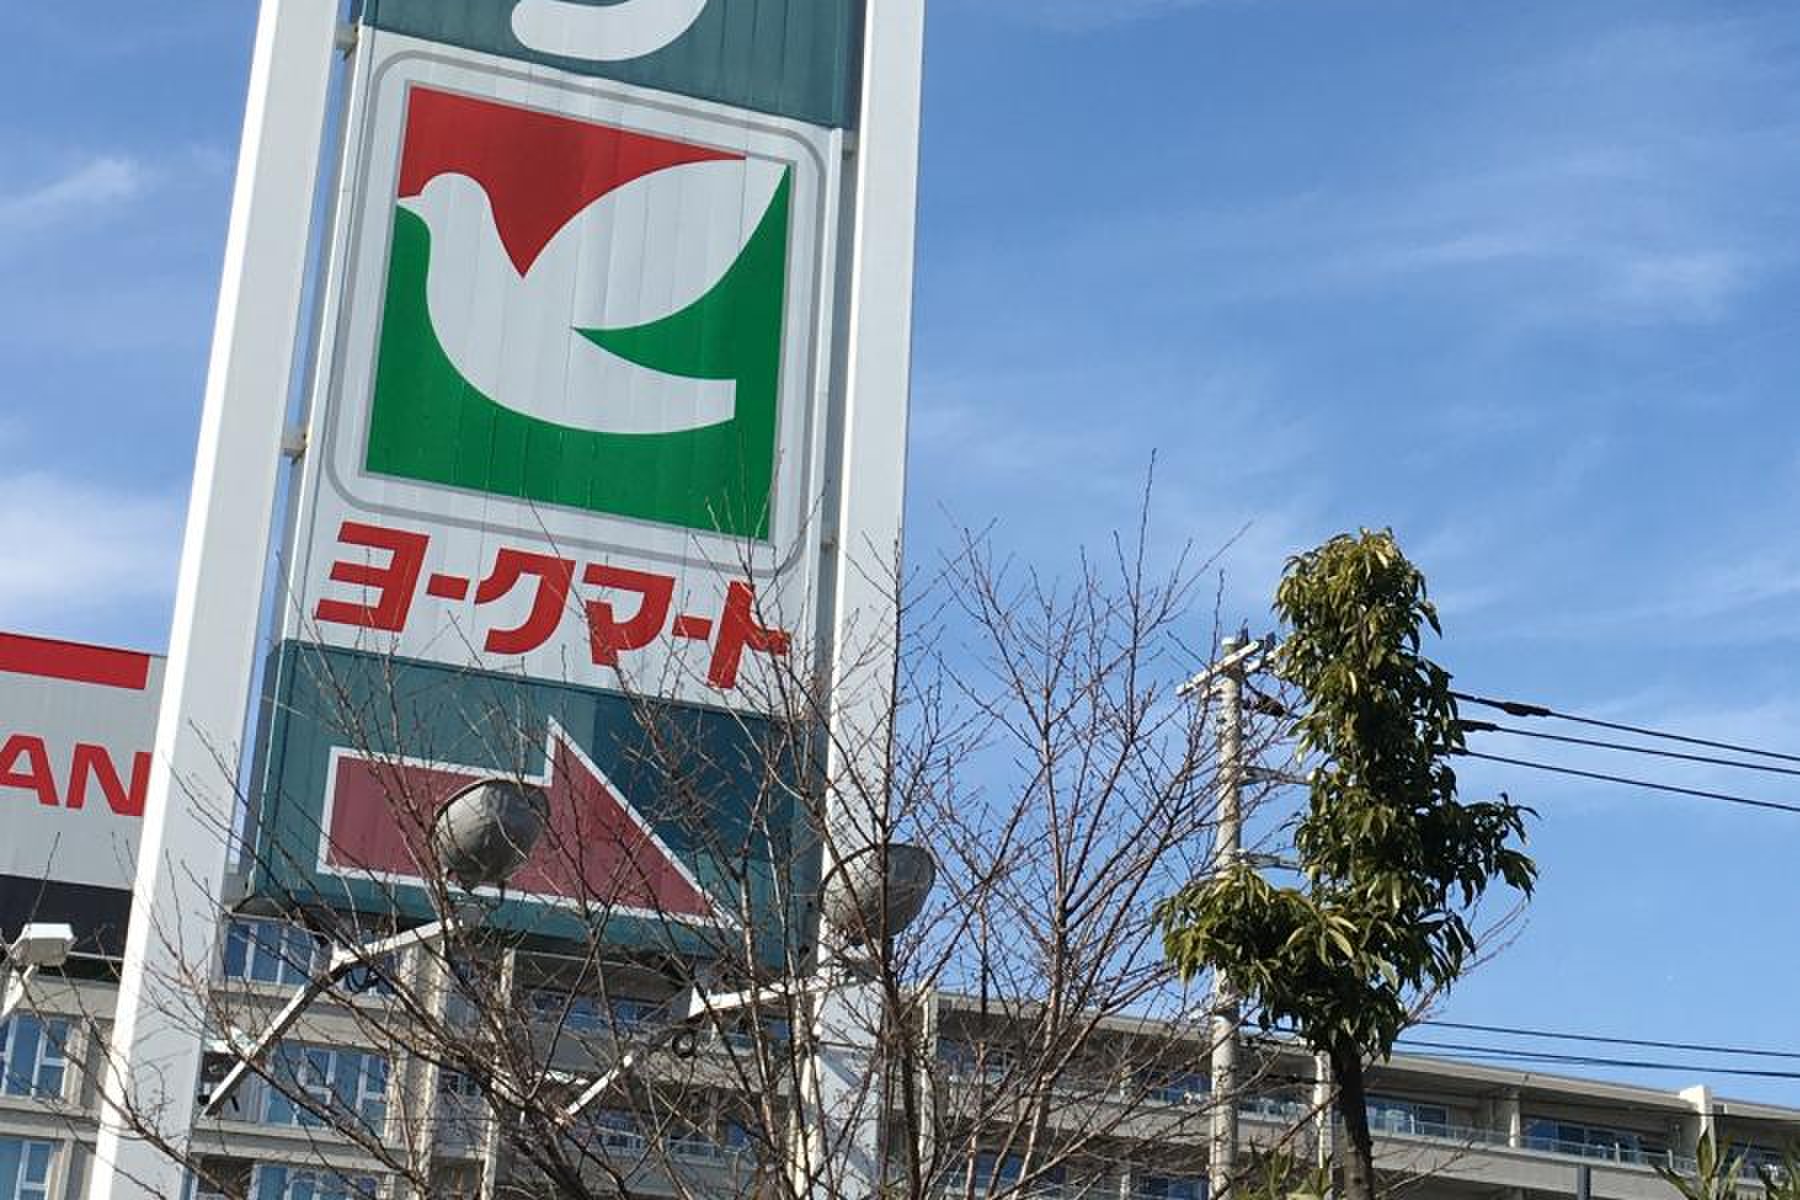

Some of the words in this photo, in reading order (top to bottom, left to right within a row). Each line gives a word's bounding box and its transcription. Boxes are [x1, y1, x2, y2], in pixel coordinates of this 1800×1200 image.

[315, 521, 792, 688] ヨークマート
[0, 734, 153, 816] AN
